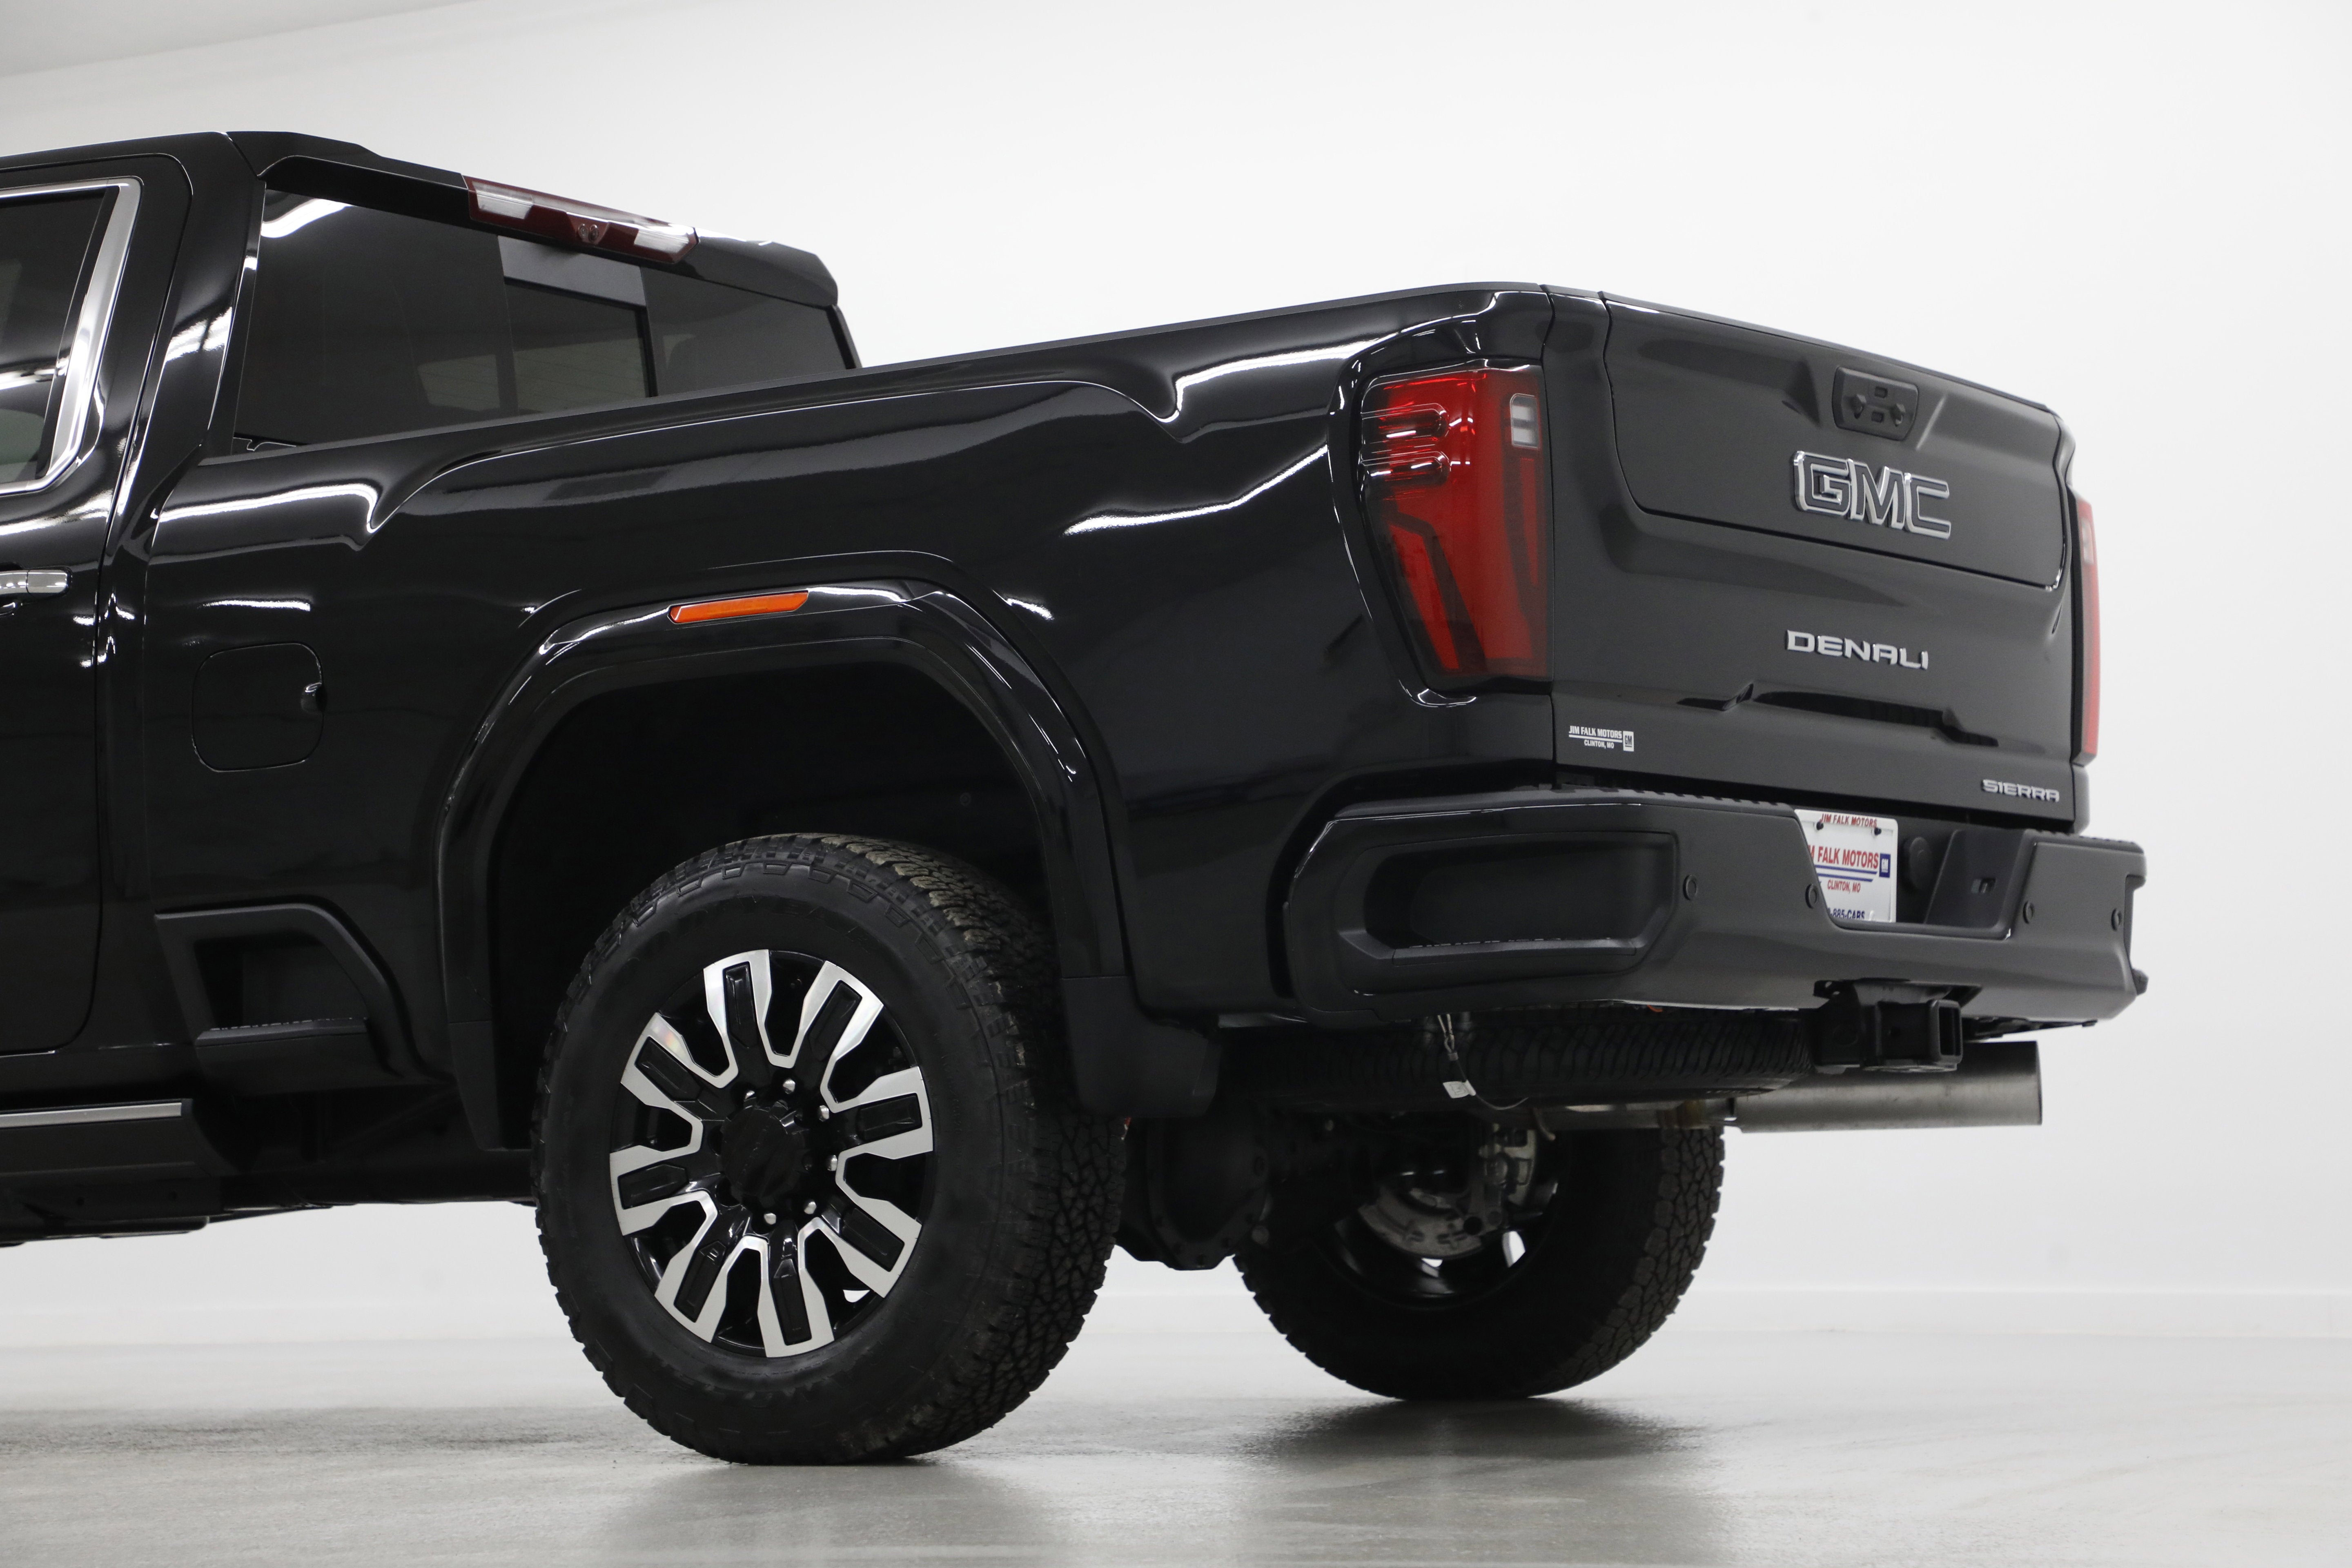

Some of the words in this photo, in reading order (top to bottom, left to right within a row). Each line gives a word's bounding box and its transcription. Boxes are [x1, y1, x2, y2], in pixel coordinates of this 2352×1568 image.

[1794, 451, 1951, 539] GMC
[1787, 630, 1929, 670] DENALI
[1569, 726, 1579, 734] JIM
[1581, 727, 1596, 736] FALK
[1597, 728, 1622, 739] MOTORS
[1625, 735, 1632, 745] GM
[1584, 739, 1606, 749] CLINTON,
[1982, 779, 2060, 802] SIERRA
[1820, 813, 1831, 823] JIM
[1833, 815, 1849, 824] FALK
[1851, 816, 1877, 828] MOTORS
[1817, 846, 1840, 864] FALK
[1842, 849, 1879, 869] MOTORS
[1827, 880, 1851, 893] CLINTON,
[1852, 882, 1861, 893] MO
